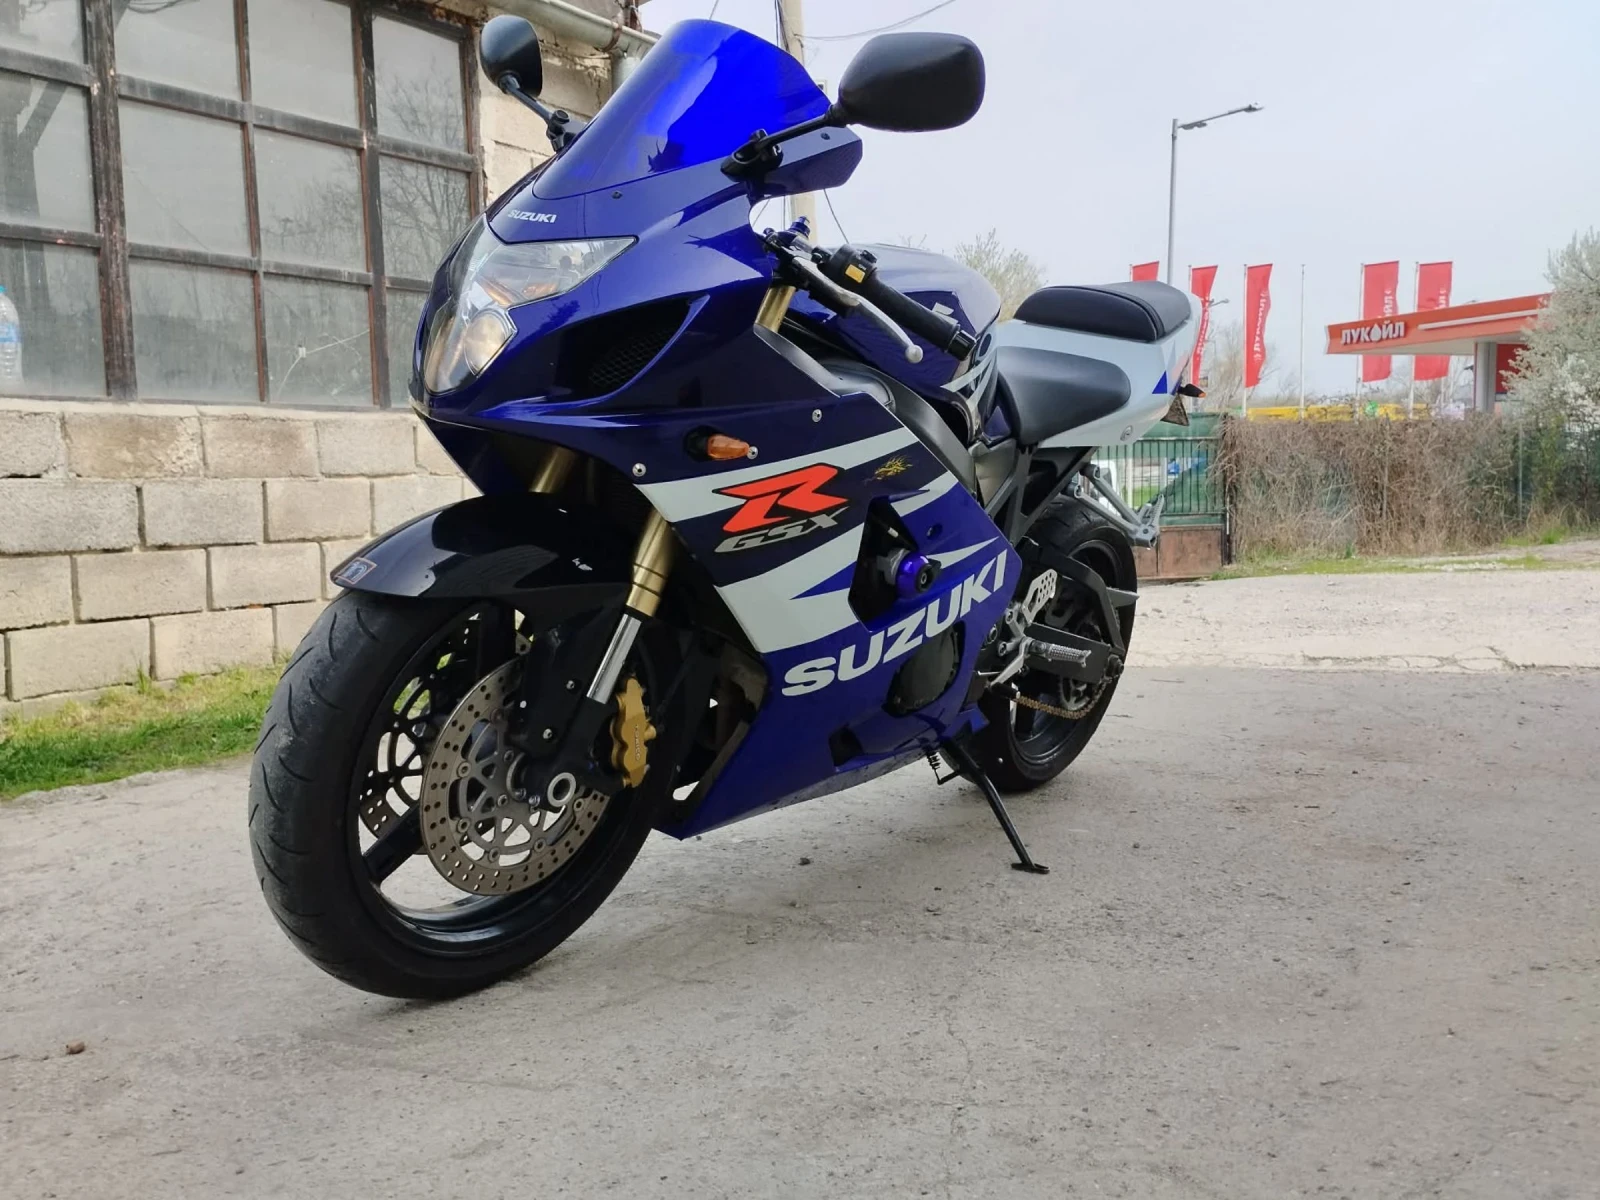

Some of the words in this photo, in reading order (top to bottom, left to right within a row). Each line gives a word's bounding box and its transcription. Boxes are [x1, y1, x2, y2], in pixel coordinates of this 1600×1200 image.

[507, 209, 558, 224] SUZUKI
[1341, 320, 1405, 345] ЛУКОЙЛ
[714, 463, 849, 533] R
[714, 506, 850, 553] GSX
[781, 549, 1008, 697] SUZUKI
